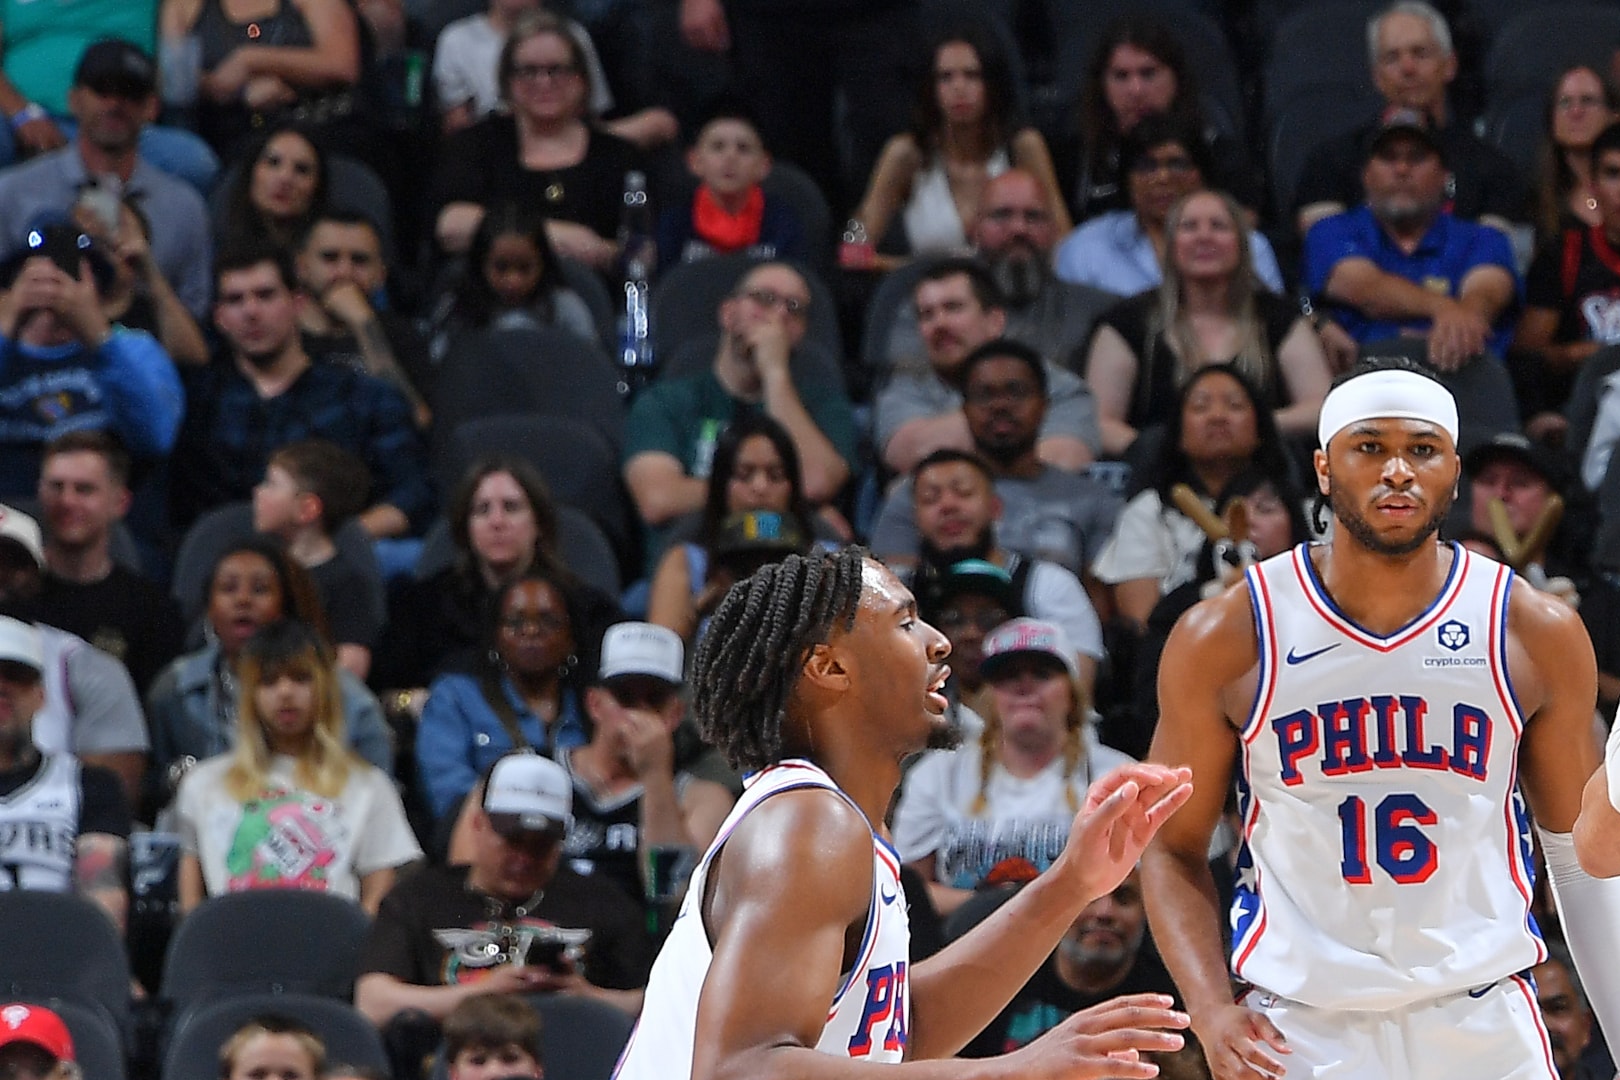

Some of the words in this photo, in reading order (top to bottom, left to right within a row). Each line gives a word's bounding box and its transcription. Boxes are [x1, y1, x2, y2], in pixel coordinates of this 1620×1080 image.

[1423, 657, 1487, 667] crypto.com
[1271, 694, 1494, 788] PHILA
[1337, 793, 1439, 886] 16
